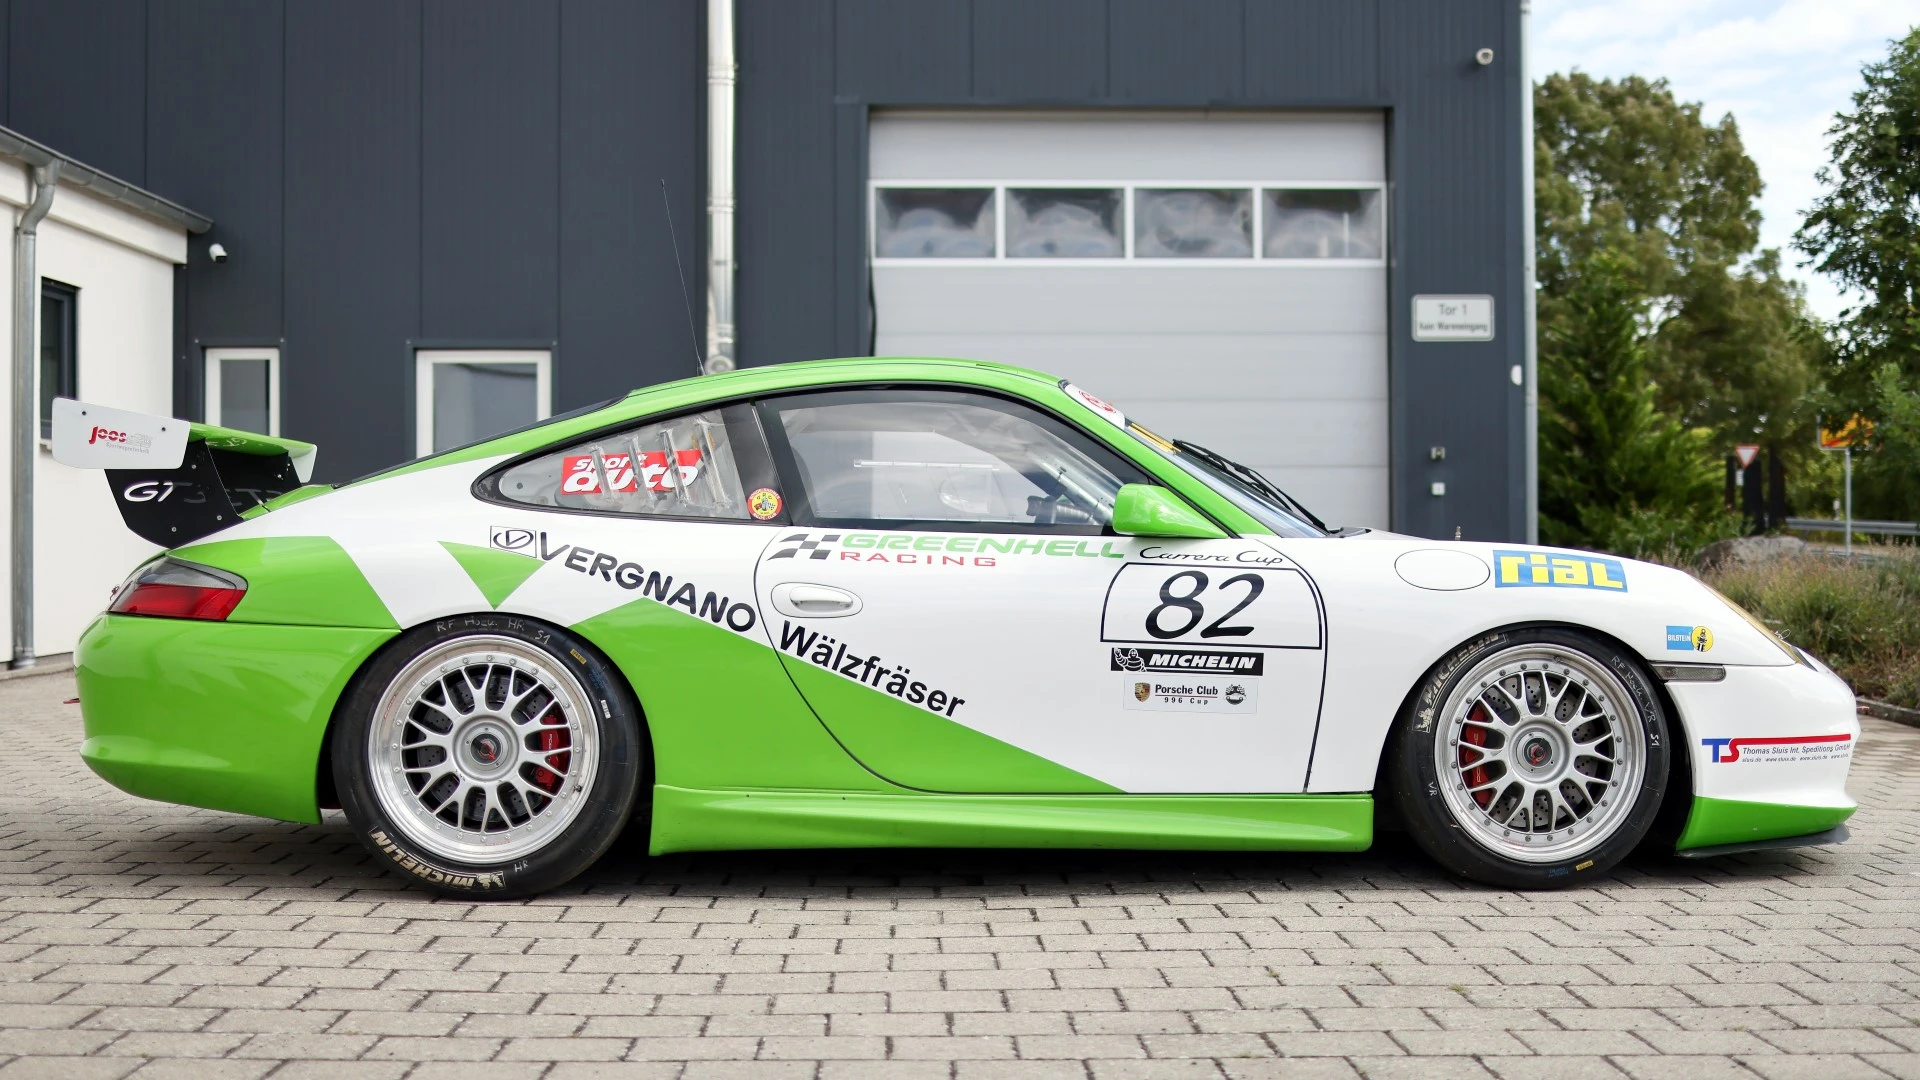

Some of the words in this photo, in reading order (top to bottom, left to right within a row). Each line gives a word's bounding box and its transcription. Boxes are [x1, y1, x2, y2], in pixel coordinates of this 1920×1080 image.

[1437, 303, 1457, 316] Tor
[1462, 303, 1467, 316] 1
[563, 464, 699, 493] auto
[842, 534, 1125, 559] GREENHELL
[1139, 546, 1230, 562] Carrera
[1236, 550, 1283, 566] Cup
[840, 551, 996, 567] RACING
[540, 531, 756, 631] VERGNANO
[1145, 570, 1265, 640] 82
[1668, 634, 1691, 642] BILSTEIN
[779, 619, 966, 717] Wälzfräser
[1149, 653, 1257, 670] MICHELIN
[1155, 684, 1194, 695] Porsche
[1196, 684, 1219, 695] Club
[1164, 696, 1183, 704] 996
[1189, 697, 1209, 706] Cup
[1702, 737, 1740, 763] TS
[1742, 747, 1770, 755] Thomas
[1772, 746, 1789, 754] Sluis
[1789, 746, 1800, 754] Int.
[370, 830, 475, 887] MICHELIN
